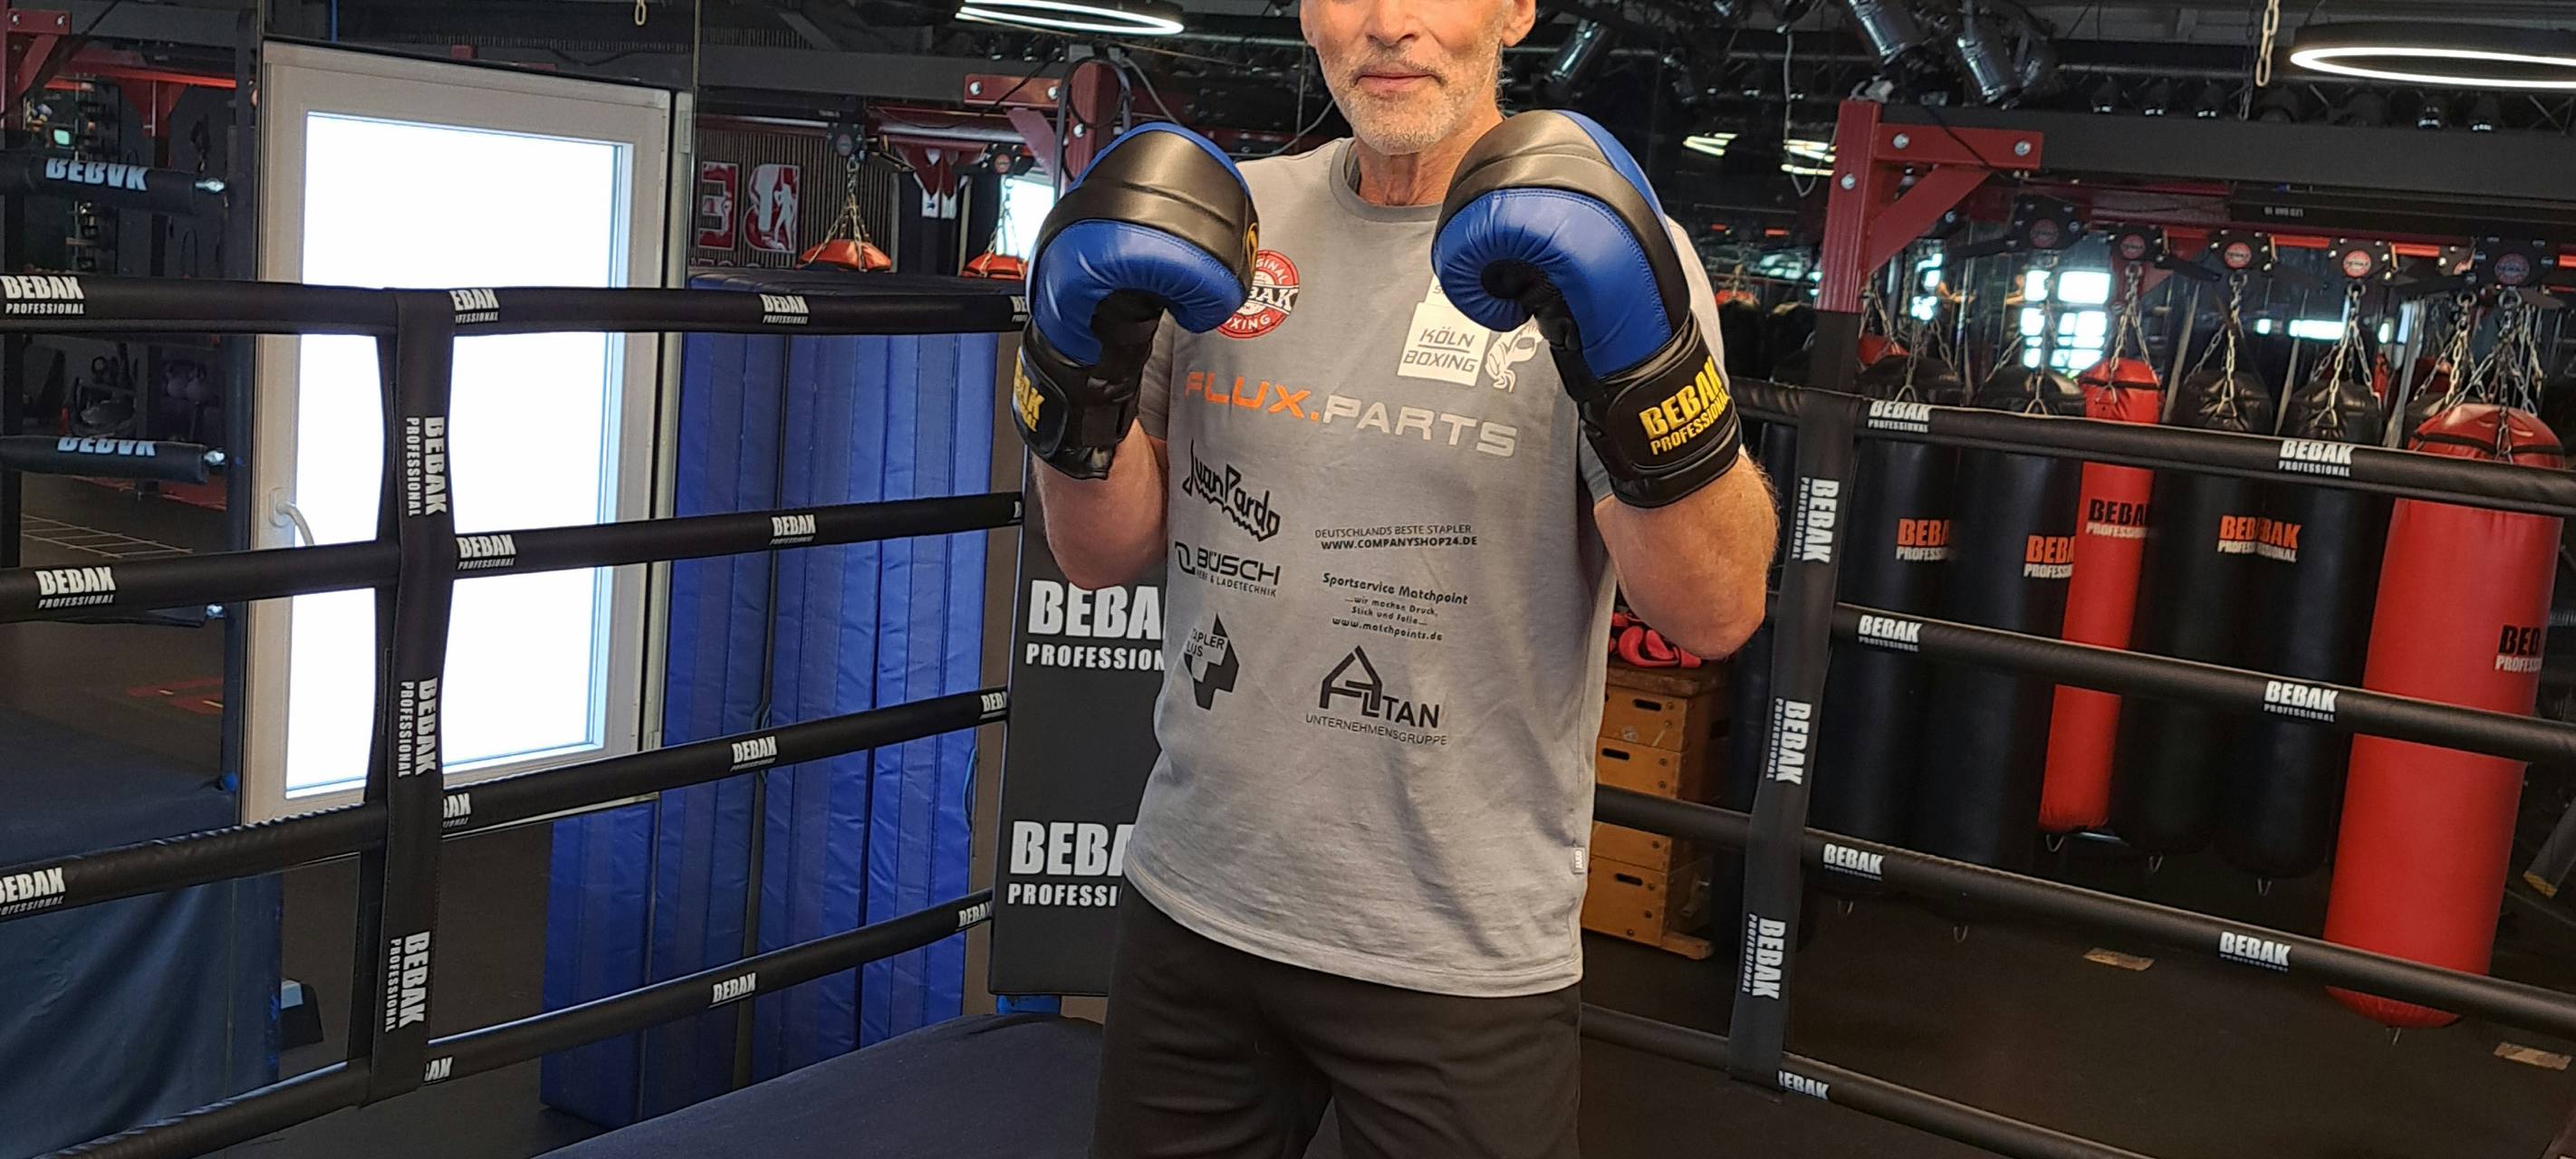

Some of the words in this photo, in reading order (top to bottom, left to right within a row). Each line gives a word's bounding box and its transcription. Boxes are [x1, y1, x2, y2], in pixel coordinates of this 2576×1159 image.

[1255, 258, 1289, 285] GINAL
[0, 275, 84, 299] BEBAK
[449, 288, 499, 311] EBAK
[5, 302, 84, 314] PROFESSIONAL
[456, 311, 498, 324] FESSIONAL
[759, 293, 809, 314] BEBAK
[1229, 313, 1271, 330] XING
[1419, 326, 1475, 348] KÖLN
[1403, 350, 1478, 373] BOXING
[1639, 355, 1723, 440] BEBAK
[1869, 399, 1931, 422] BEBAK
[1185, 370, 1518, 458] FLUX.PARTS
[1650, 388, 1731, 455] PROFESSIONAL
[406, 417, 421, 516] PROFESSIONAL
[425, 417, 447, 515] BEBAK
[2280, 440, 2355, 465] BEBAK
[2278, 460, 2350, 477] PROFESSIONAL
[771, 513, 816, 537] BEBAK
[1802, 478, 1840, 563] BEBAK
[2088, 498, 2148, 526] BEBA
[1314, 526, 1392, 539] DEUTSCHLANDS
[1395, 525, 1424, 535] BESTE
[1427, 523, 1472, 534] STAPLER
[1321, 535, 1478, 551] WWW.COMPANYSHOP24.DE
[456, 534, 516, 559] BEBAK
[2025, 535, 2076, 563] BEBA
[1196, 547, 1282, 586] BÜSCH
[35, 567, 117, 596] BEBAK
[1216, 576, 1277, 598] LADETECHNIK
[1322, 572, 1395, 594] Sportservice
[1399, 586, 1469, 605] Matchpoint
[38, 594, 114, 609] PROFESSIONAL
[1028, 580, 1162, 640] BEBA
[1376, 609, 1394, 620] und
[1331, 617, 1443, 642] www.matchpoints.de
[1858, 614, 1923, 643] BEBAK
[2498, 625, 2542, 656] BEB
[1025, 643, 1166, 671] PROFESSION
[1187, 639, 1204, 657] LUS
[2264, 681, 2339, 713] BEBAK
[398, 681, 415, 778] PROFESSIONAL
[415, 677, 438, 776] BEBAK
[1305, 713, 1448, 746] UNTERNEHMENSGRUPPE
[731, 735, 778, 763] BEBAK
[1775, 700, 1812, 785] BEBAK
[1010, 820, 1136, 876] BEBA
[1823, 843, 1884, 875] BEBAK
[0, 896, 64, 915] OFESSIONAL
[1007, 883, 1118, 906] PROFESSI
[1752, 917, 1786, 1000] BEBAK
[2219, 931, 2292, 966] BEBAK
[385, 938, 402, 1033] PROFESSIONAL
[399, 931, 431, 1029] BEBAK
[711, 972, 756, 1003] BEBAK
